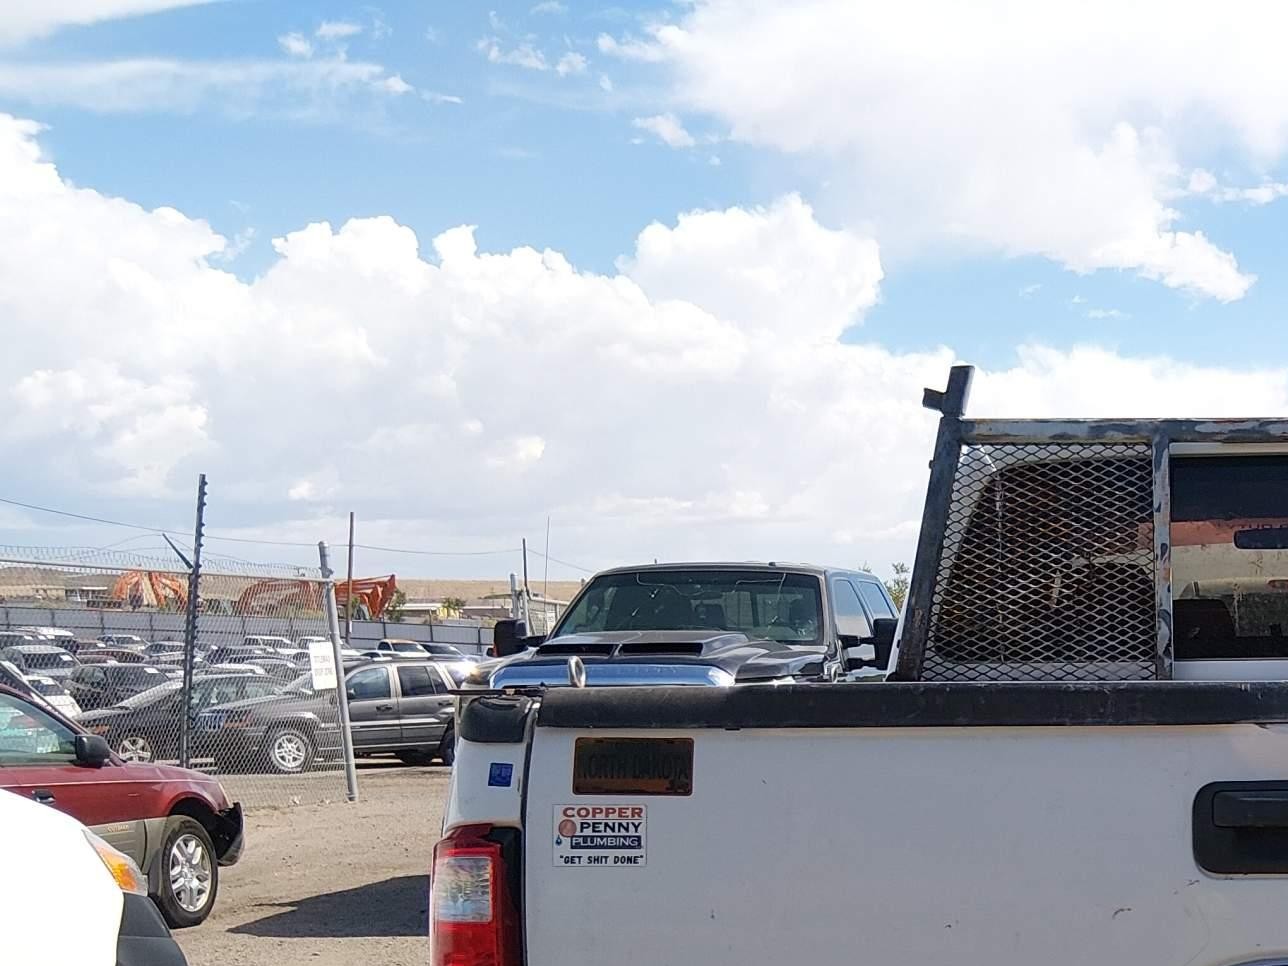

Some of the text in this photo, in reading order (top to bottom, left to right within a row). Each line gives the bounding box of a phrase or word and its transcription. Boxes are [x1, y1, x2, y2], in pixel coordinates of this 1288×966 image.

[562, 807, 644, 819] COPPER
[579, 821, 643, 834] PENNY
[572, 837, 639, 847] PLUMBING
[587, 855, 610, 865] SHIT
